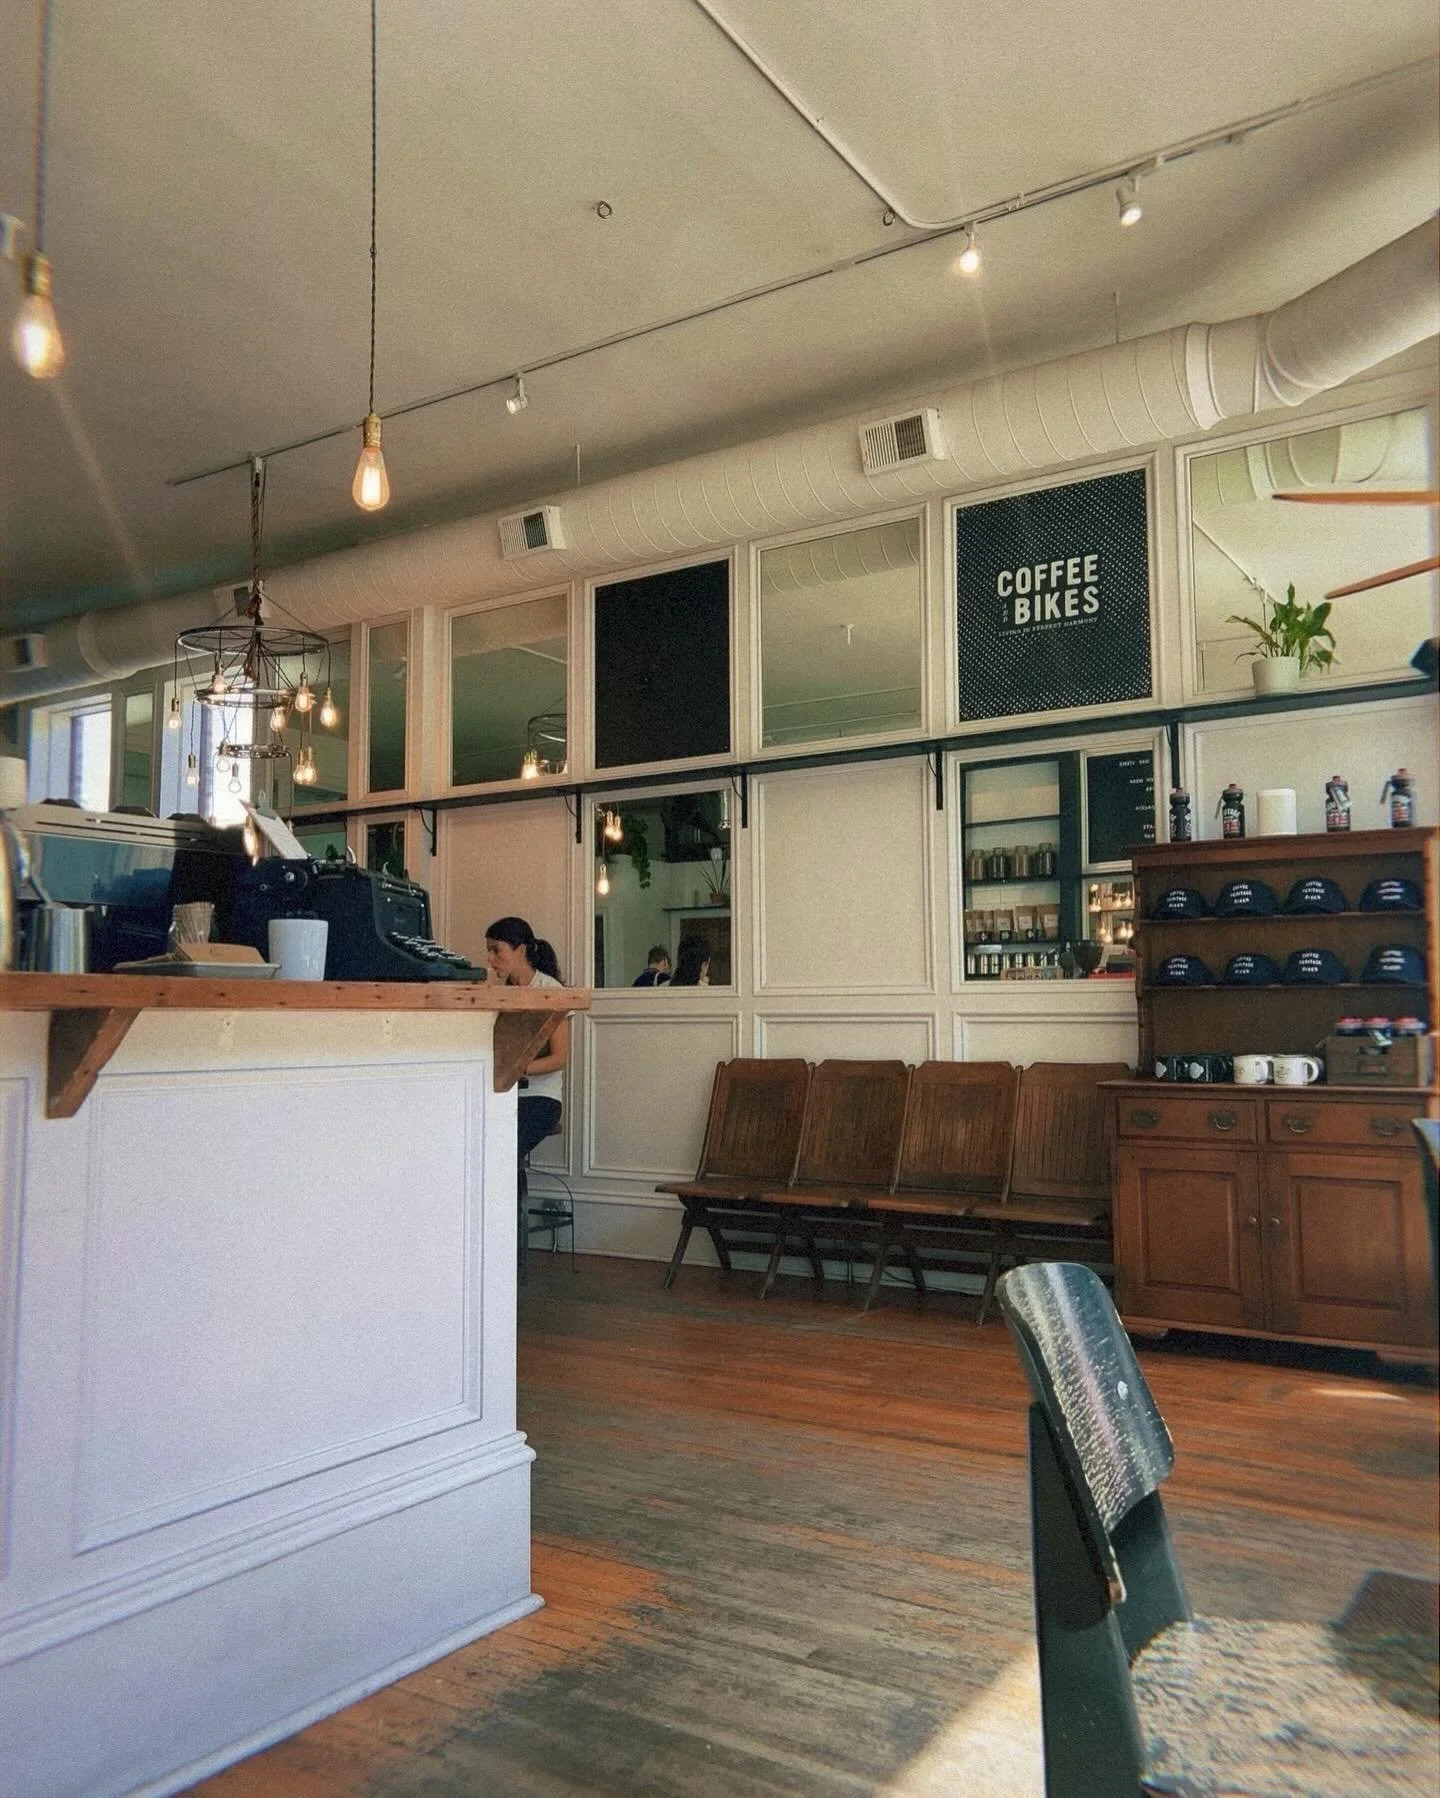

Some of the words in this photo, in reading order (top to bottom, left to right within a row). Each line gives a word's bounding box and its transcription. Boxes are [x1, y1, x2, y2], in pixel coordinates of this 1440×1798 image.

[997, 554, 1099, 597] COFFEE
[1014, 586, 1100, 625] BIKES
[1032, 622, 1062, 632] PERFECT
[1063, 617, 1098, 628] HARMONY
